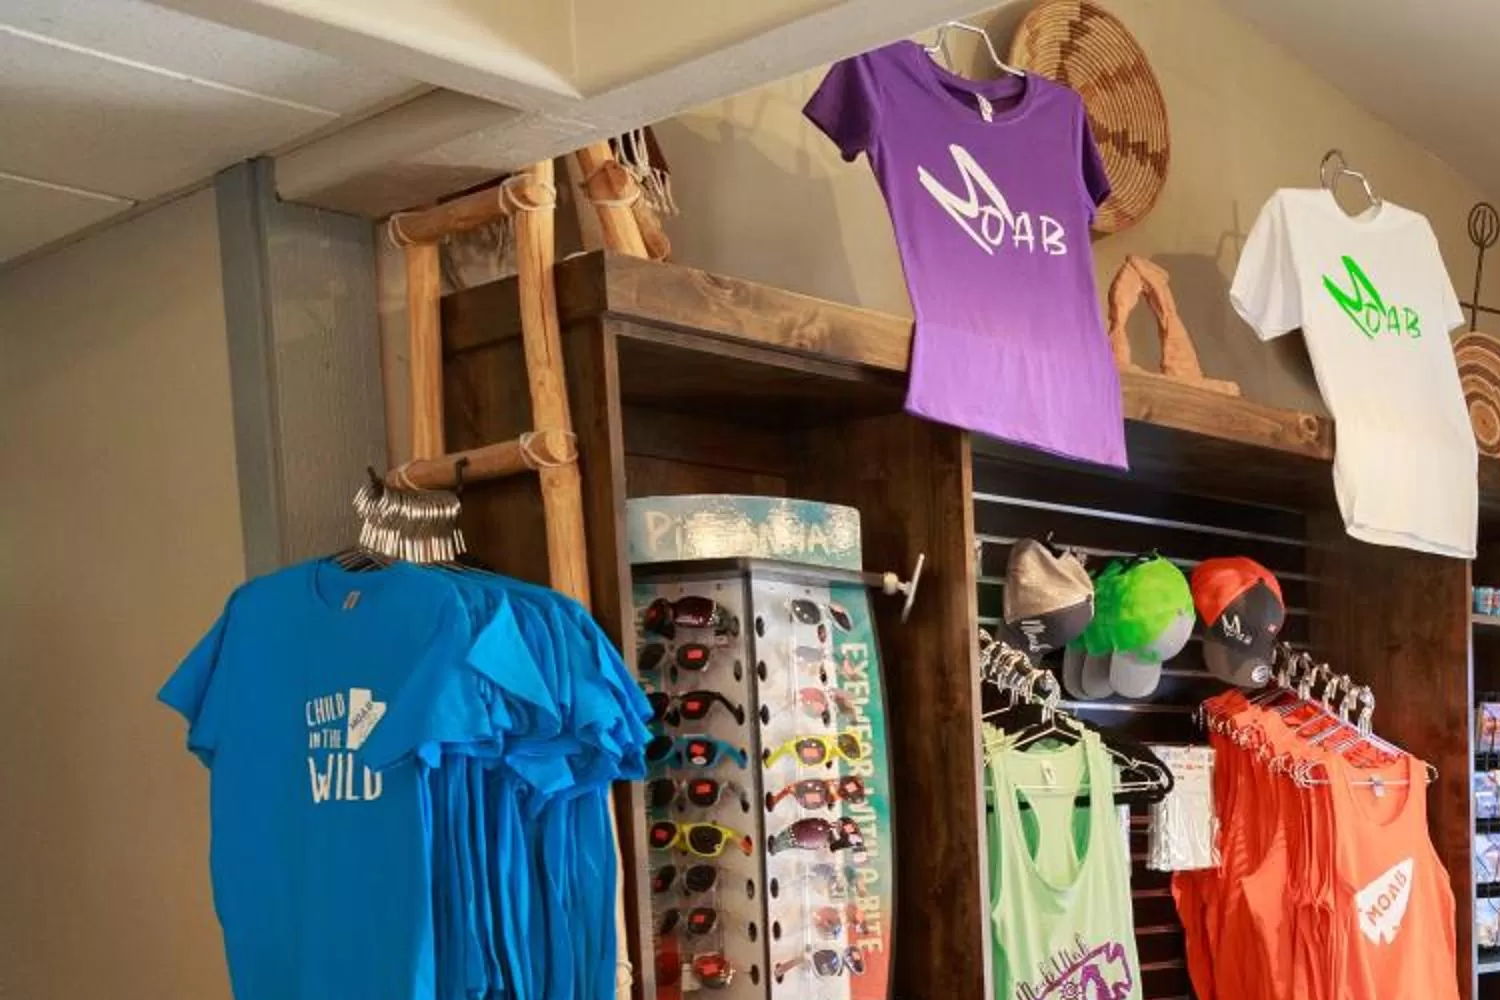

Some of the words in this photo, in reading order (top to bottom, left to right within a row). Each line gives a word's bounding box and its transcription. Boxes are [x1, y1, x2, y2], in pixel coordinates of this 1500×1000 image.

[917, 143, 1068, 256] MOAB
[1322, 255, 1422, 340] MOAB
[305, 692, 346, 727] CHILD
[307, 752, 383, 804] WILD
[1366, 870, 1407, 927] MOAB
